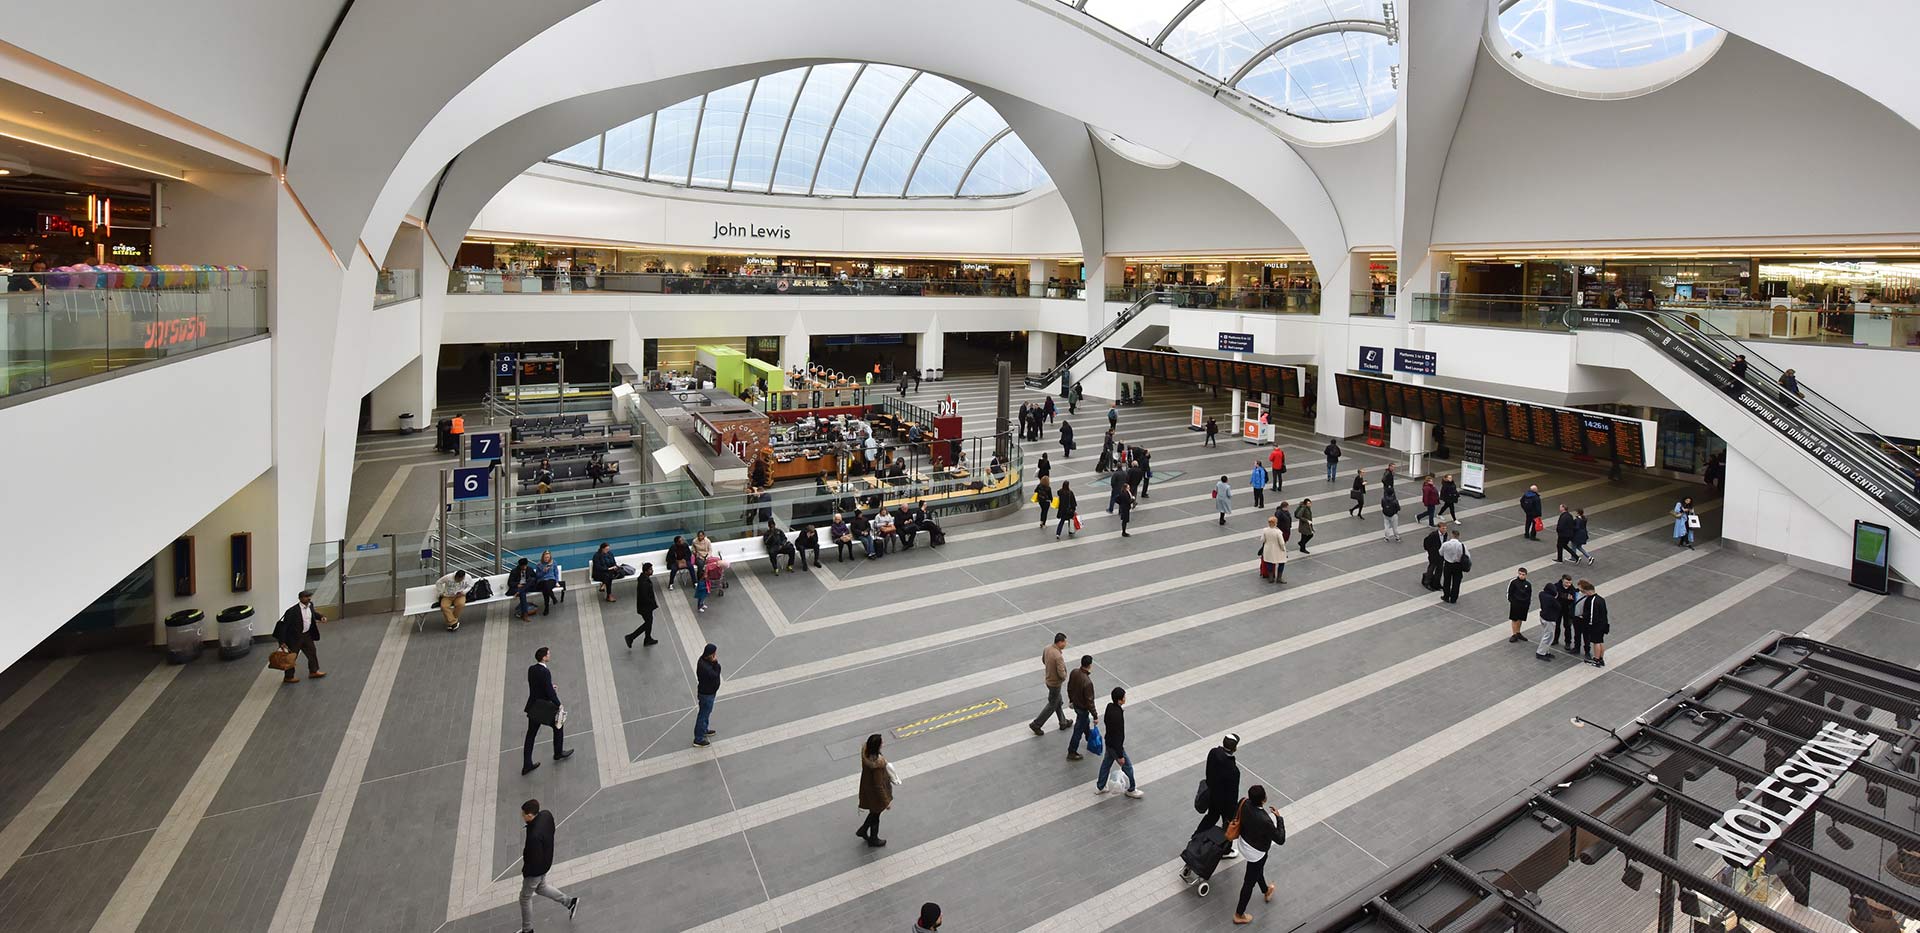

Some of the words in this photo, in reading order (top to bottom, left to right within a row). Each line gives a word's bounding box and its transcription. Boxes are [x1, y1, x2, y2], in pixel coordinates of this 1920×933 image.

[713, 221, 746, 239] John
[751, 223, 791, 239] Lewis
[747, 257, 760, 265] John
[501, 363, 508, 372] 8
[940, 400, 959, 415] PRET
[739, 424, 760, 445] COFFEE
[1800, 428, 1811, 437] THIS
[479, 439, 491, 454] 7
[729, 440, 748, 458] RET
[1738, 393, 1773, 421] SHOPPING
[1772, 418, 1788, 431] AND
[1787, 428, 1814, 450] DINING
[1813, 446, 1826, 457] AT
[1823, 453, 1851, 475] GRAND
[1849, 472, 1886, 500] CENTRAL
[464, 474, 478, 492] 6
[1692, 721, 1880, 867] MOLESKINE
